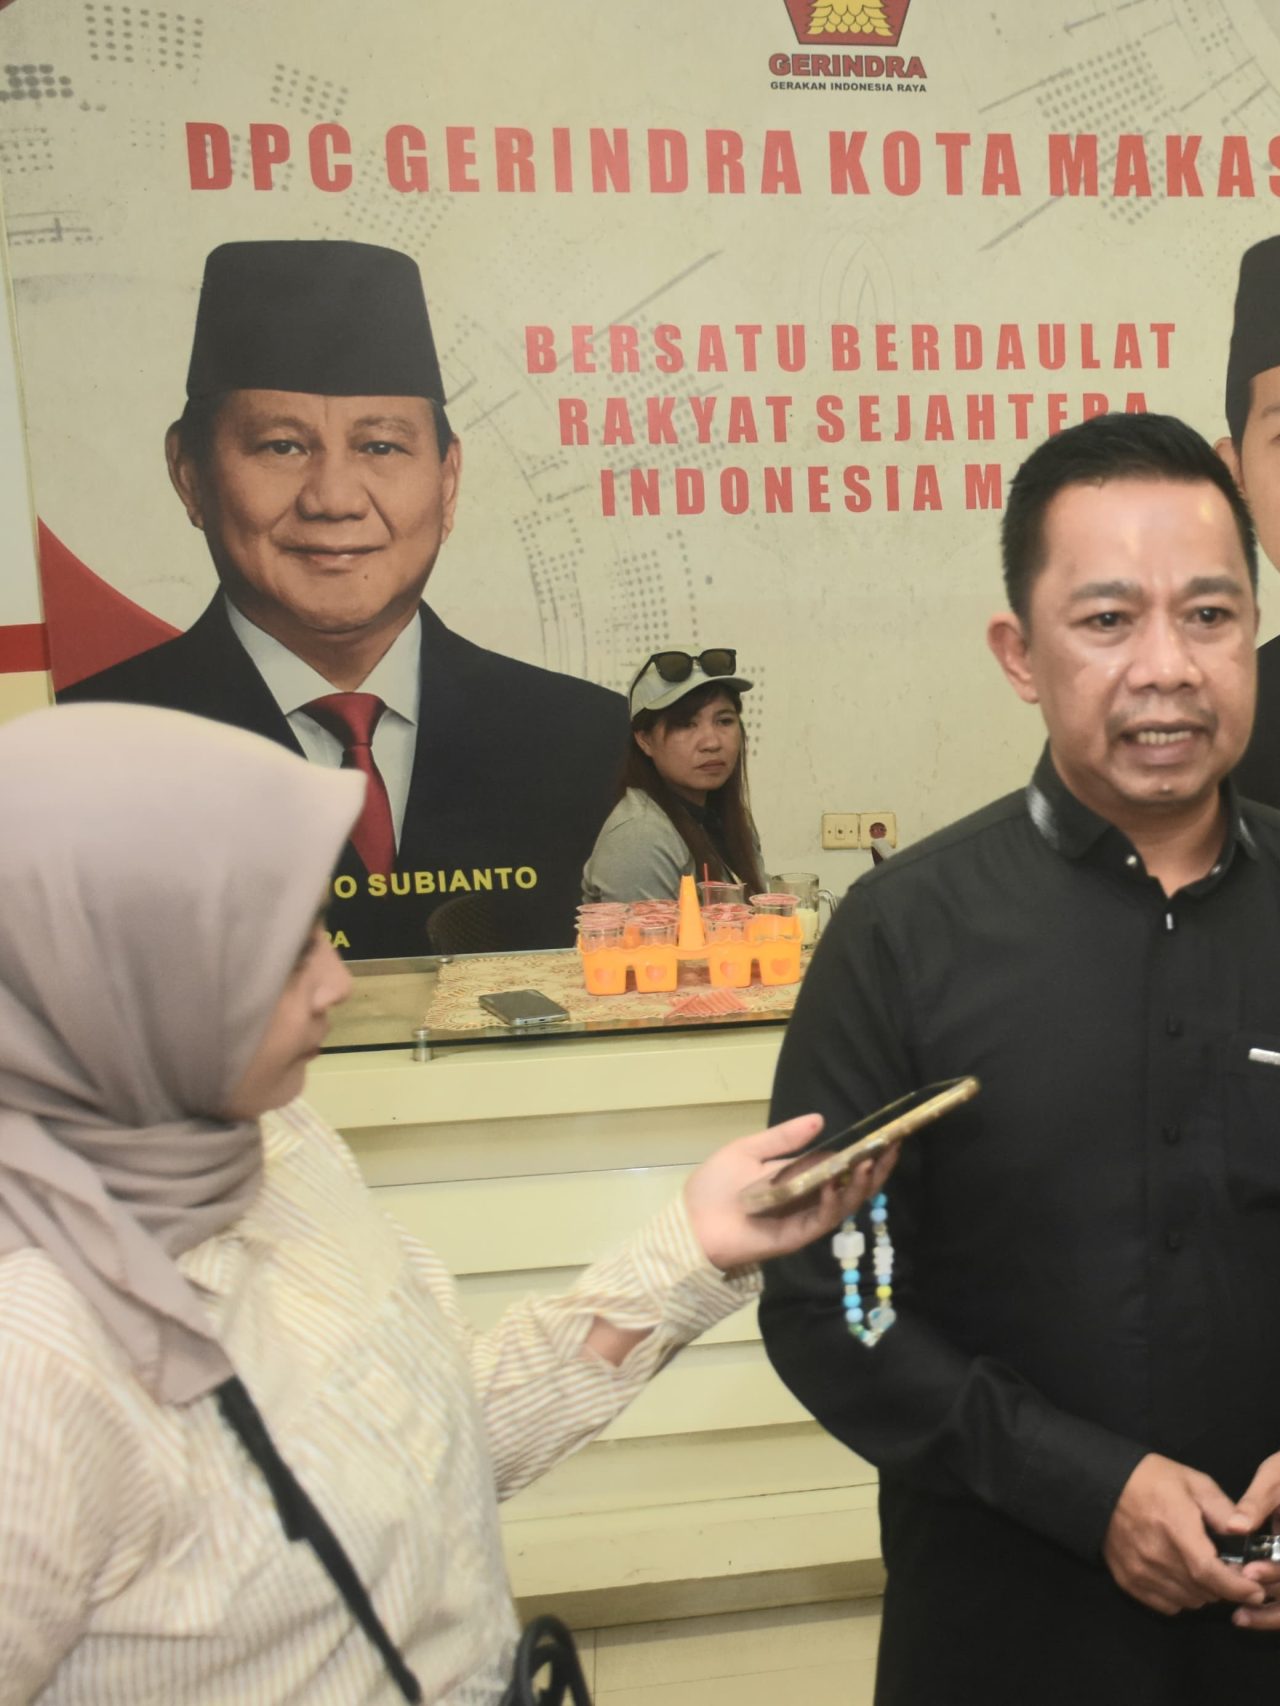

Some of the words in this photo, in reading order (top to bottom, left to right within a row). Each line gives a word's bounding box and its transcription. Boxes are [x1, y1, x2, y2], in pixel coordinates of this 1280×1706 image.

[768, 53, 928, 79] GERINDRA
[770, 81, 827, 91] GERAKAN
[830, 82, 893, 92] INDONESIA
[896, 83, 927, 93] RAYA
[185, 122, 353, 192] DPC
[385, 124, 802, 195] GERINDRA
[828, 130, 1021, 197] KOTA
[524, 324, 806, 374] BERSATU
[831, 322, 1176, 372] BERDAULAT
[558, 395, 793, 446] RAKYAT
[601, 463, 944, 517] INDONESIA
[367, 866, 538, 897] SUBIANTO
